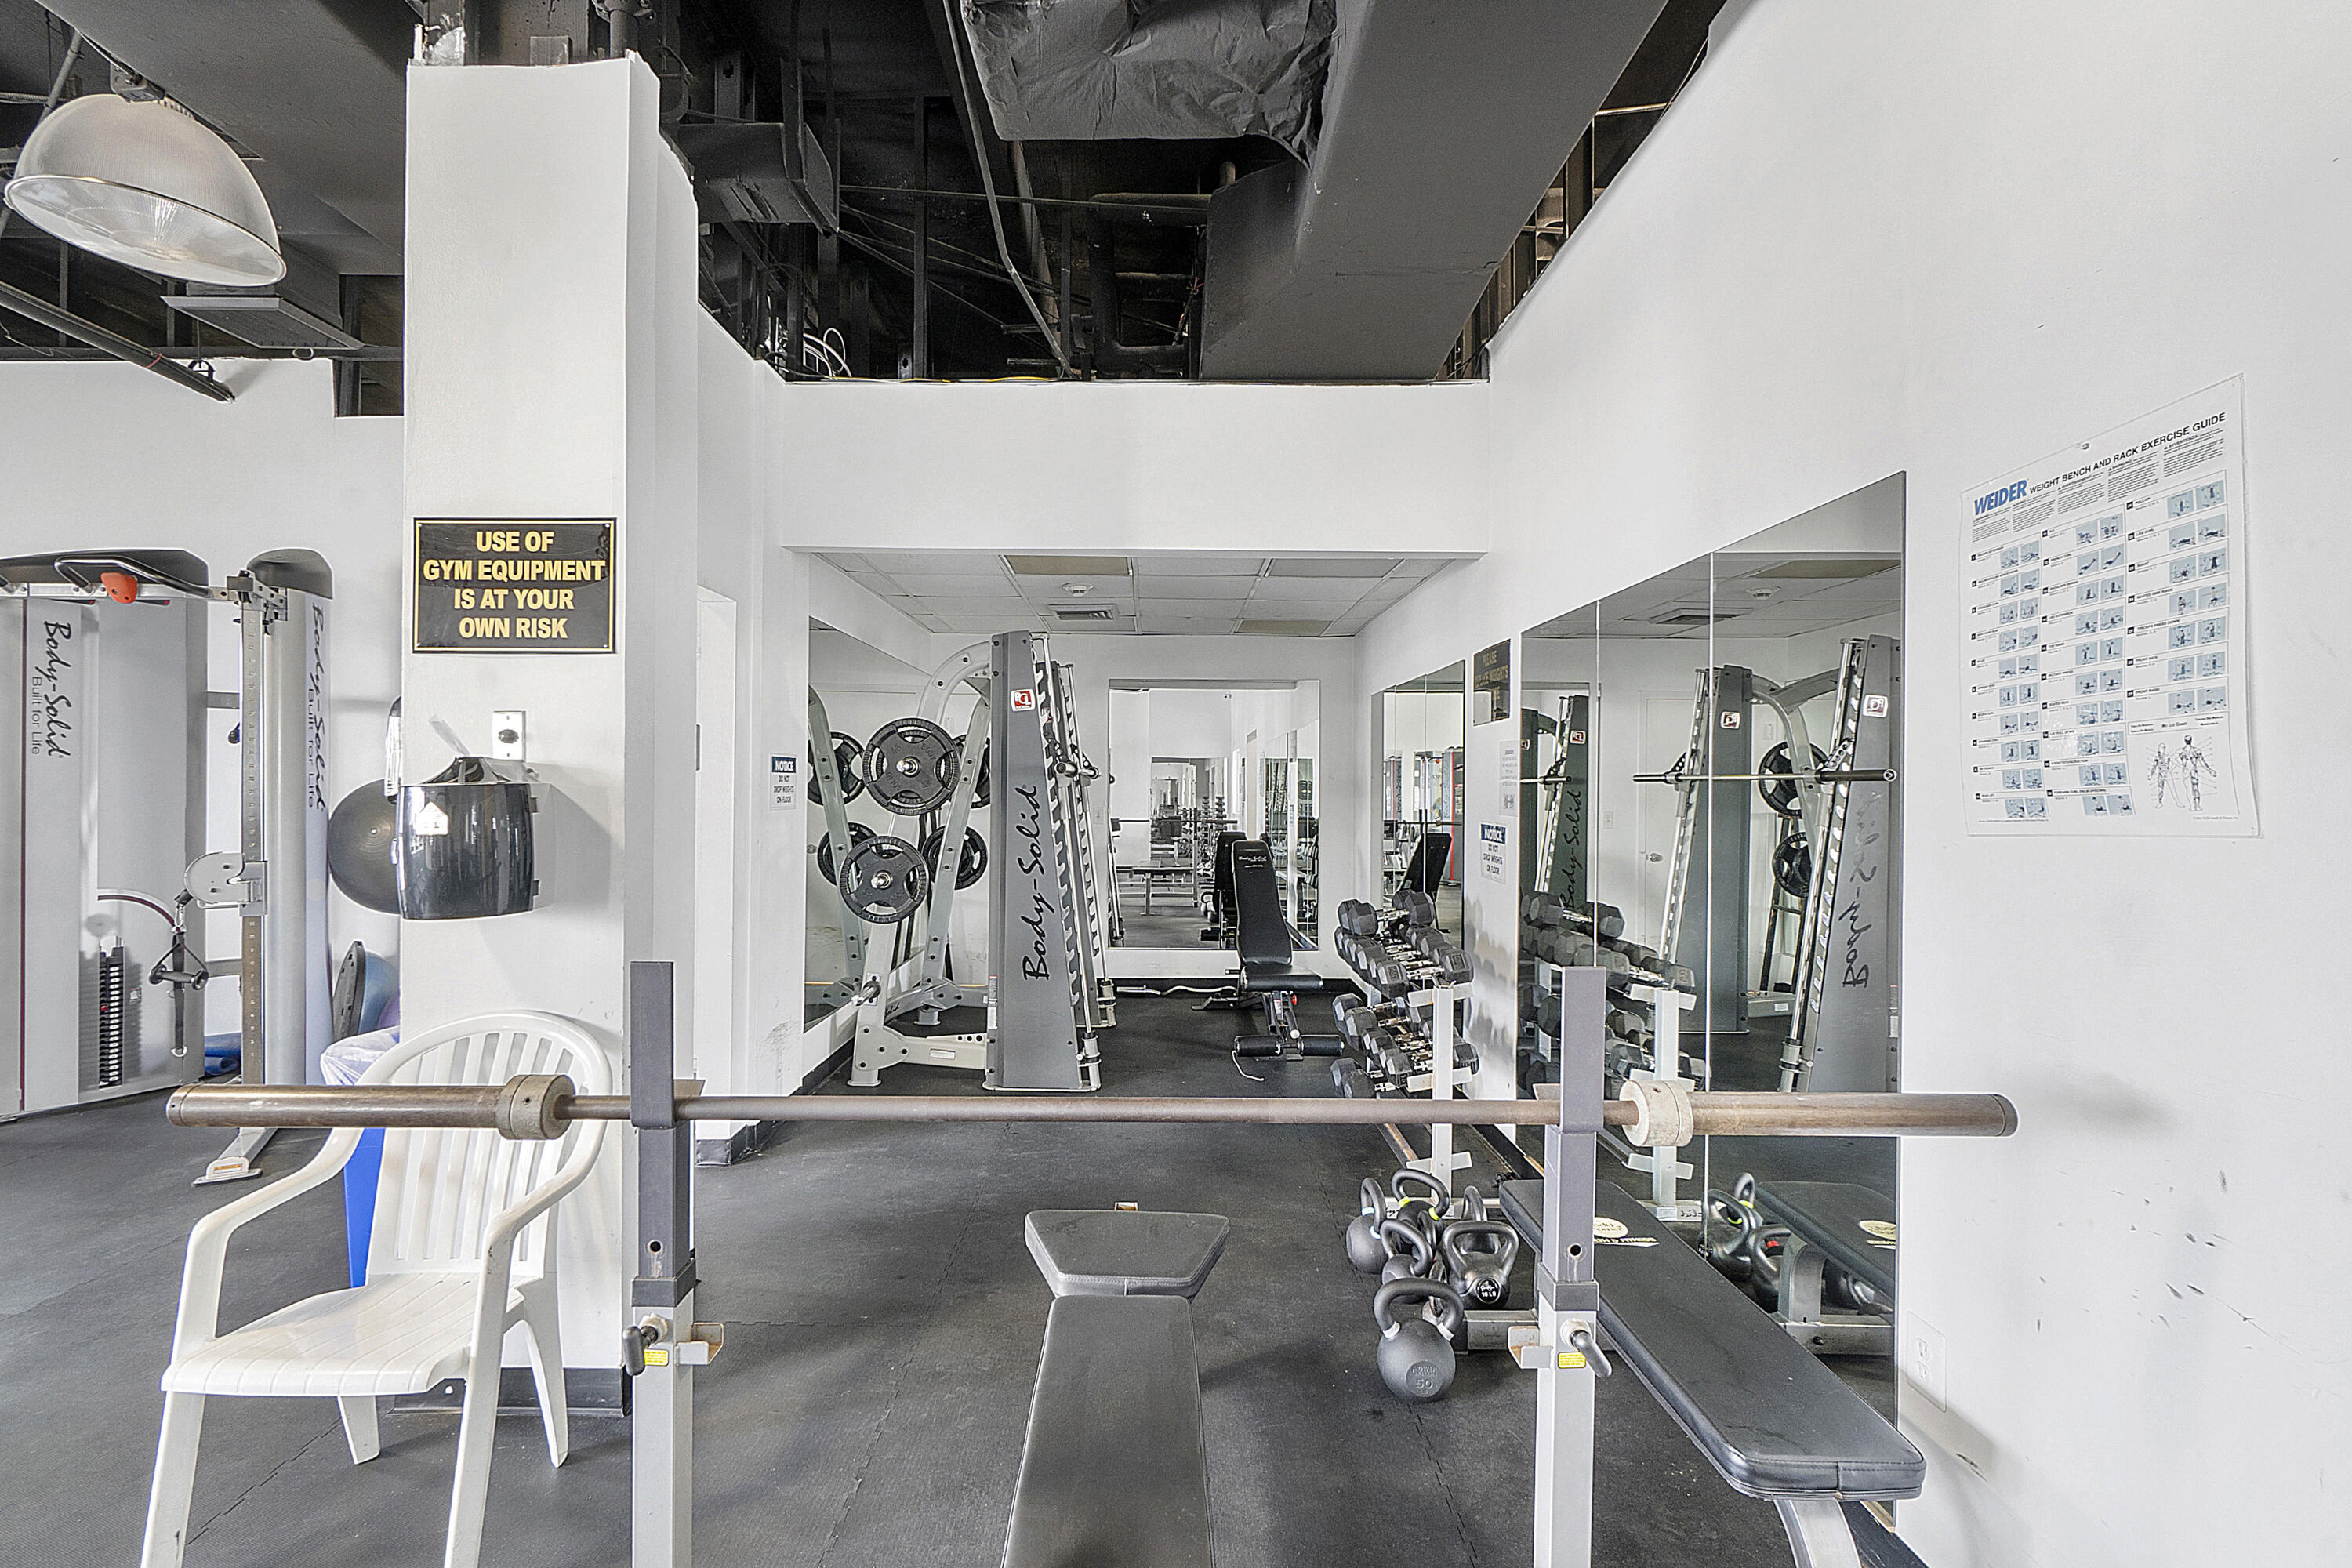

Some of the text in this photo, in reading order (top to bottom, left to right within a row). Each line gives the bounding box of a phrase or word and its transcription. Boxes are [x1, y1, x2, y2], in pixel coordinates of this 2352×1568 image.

[2029, 412, 2227, 494] WEIGHT BENCH AND RACK EXERCISE GUIDE
[1973, 479, 2028, 515] WEIDER
[476, 531, 554, 552] USE OF
[423, 560, 606, 583] GYM EQUIPMENT
[454, 588, 575, 610] IS AT YOUR
[459, 617, 568, 639] OWN RISK
[35, 621, 72, 757] Body-Solid
[31, 677, 42, 754] Built for Life
[310, 602, 325, 811] Body-Solid
[775, 760, 794, 772] NOTICE
[1484, 827, 1503, 842] NOTICE
[1014, 785, 1054, 980] Body-Solid
[1416, 1378, 1434, 1390] 50
